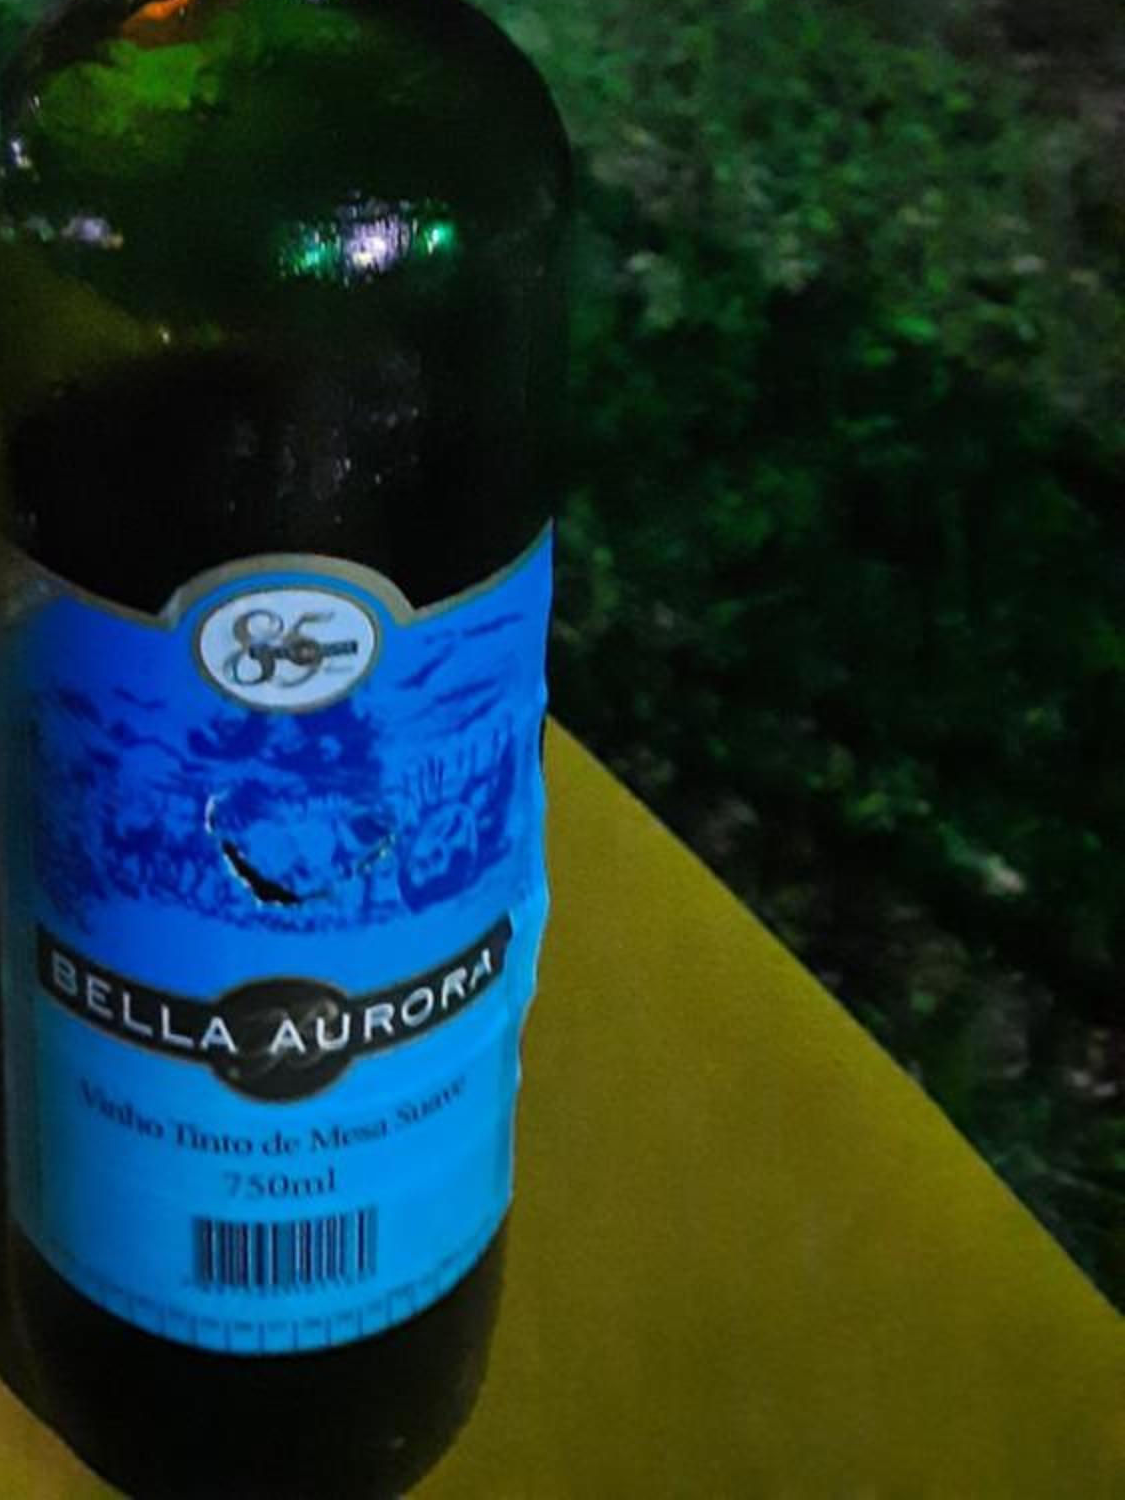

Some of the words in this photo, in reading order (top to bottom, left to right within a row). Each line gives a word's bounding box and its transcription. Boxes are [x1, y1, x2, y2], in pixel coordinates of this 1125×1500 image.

[52, 950, 238, 1054] BELLA
[269, 948, 493, 1054] AURORA
[79, 1076, 165, 1140] Vinho
[175, 1122, 253, 1156] Tinto
[262, 1130, 300, 1156] de
[310, 1119, 388, 1153] Mesa
[394, 1075, 468, 1126] Suave
[222, 1164, 336, 1198] 750ml
